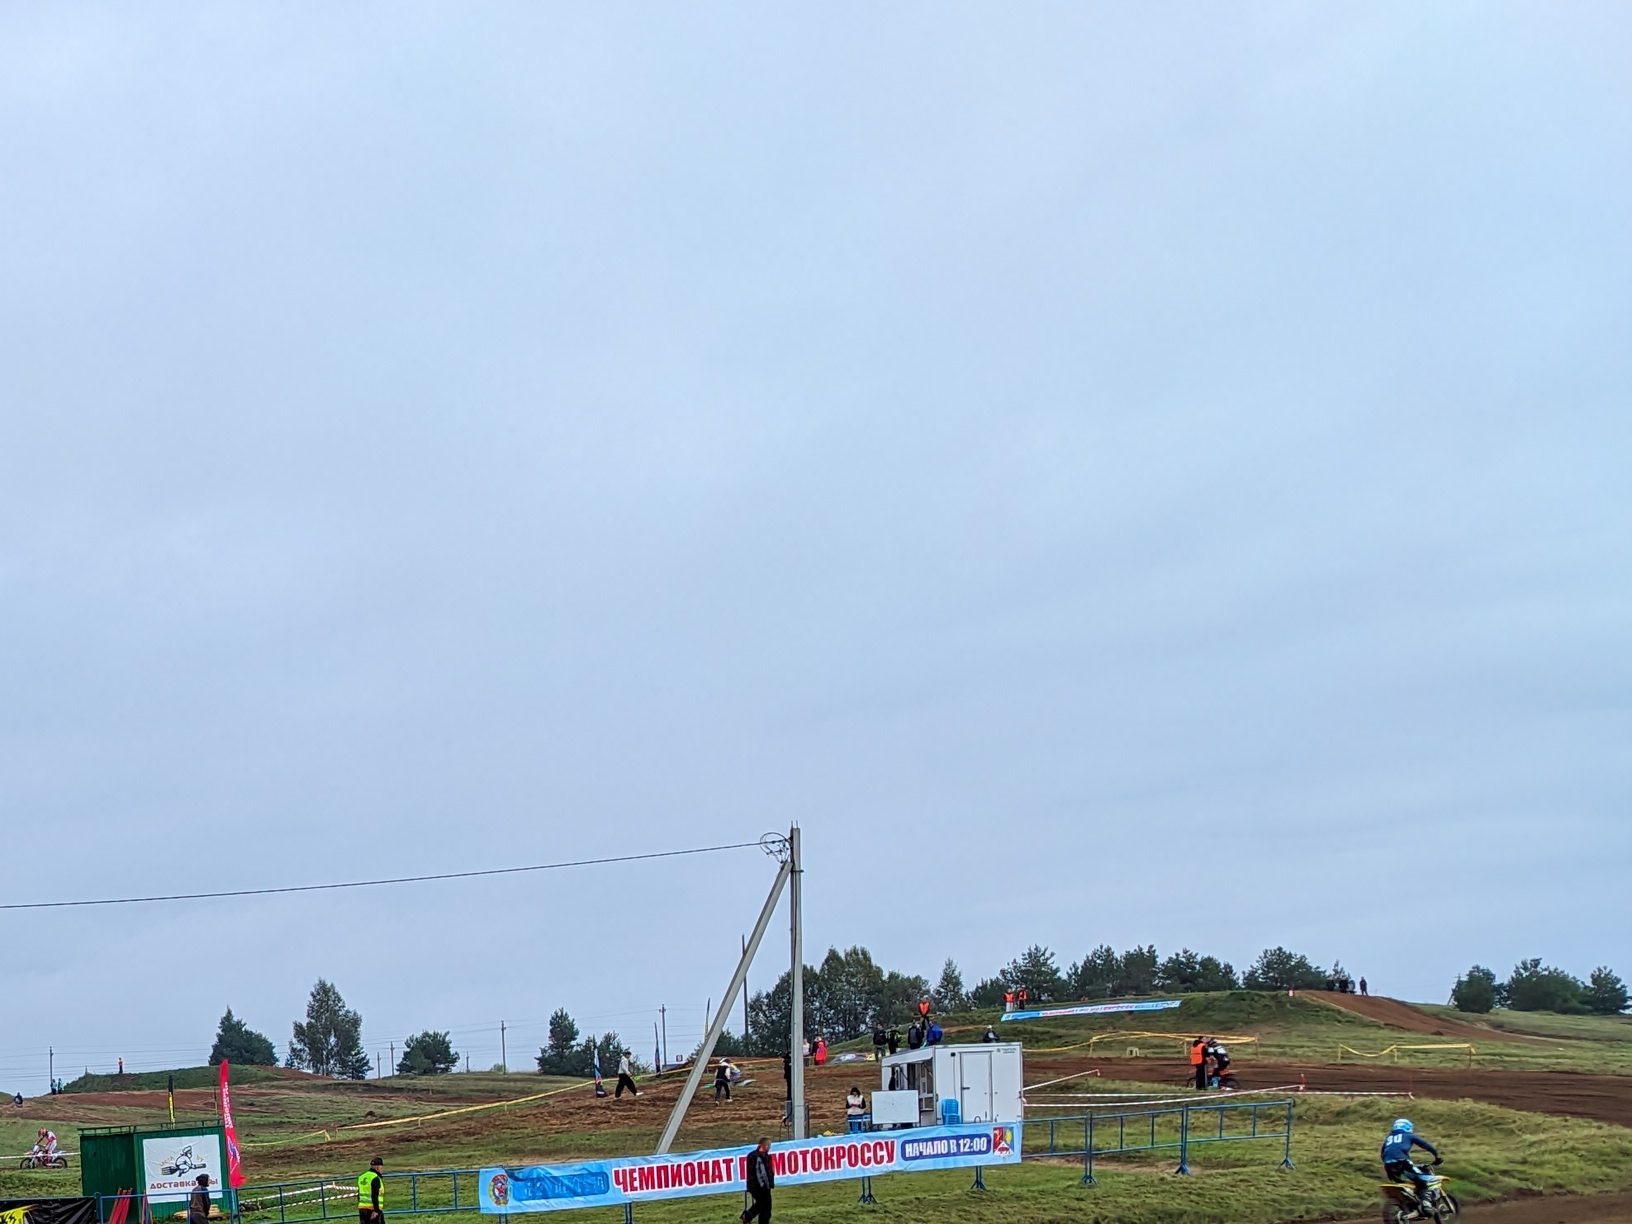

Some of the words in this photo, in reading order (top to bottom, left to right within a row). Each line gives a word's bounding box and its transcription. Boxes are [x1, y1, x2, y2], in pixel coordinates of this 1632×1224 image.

[904, 1140, 950, 1158] НАЧАЛО
[949, 1140, 957, 1154] В
[959, 1136, 988, 1154] 12:00
[613, 1158, 734, 1194] ЧЕМПИОНАТ
[770, 1139, 896, 1177] МОТОКРОССУ
